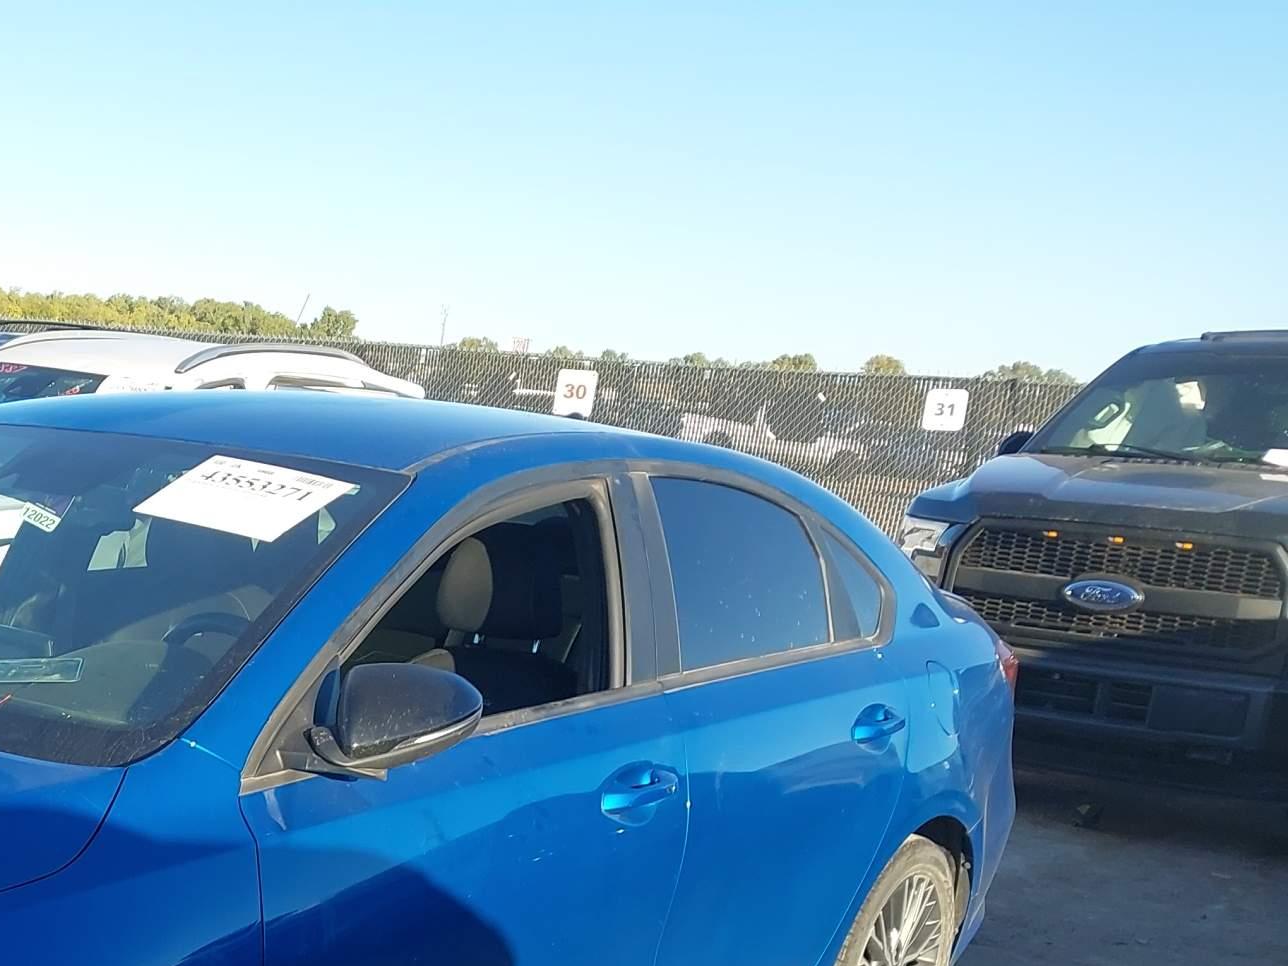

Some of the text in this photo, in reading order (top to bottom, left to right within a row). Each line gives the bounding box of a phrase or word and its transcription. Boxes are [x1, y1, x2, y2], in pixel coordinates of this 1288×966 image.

[562, 383, 587, 400] 30
[934, 402, 957, 417] 31
[200, 470, 314, 501] 43553271
